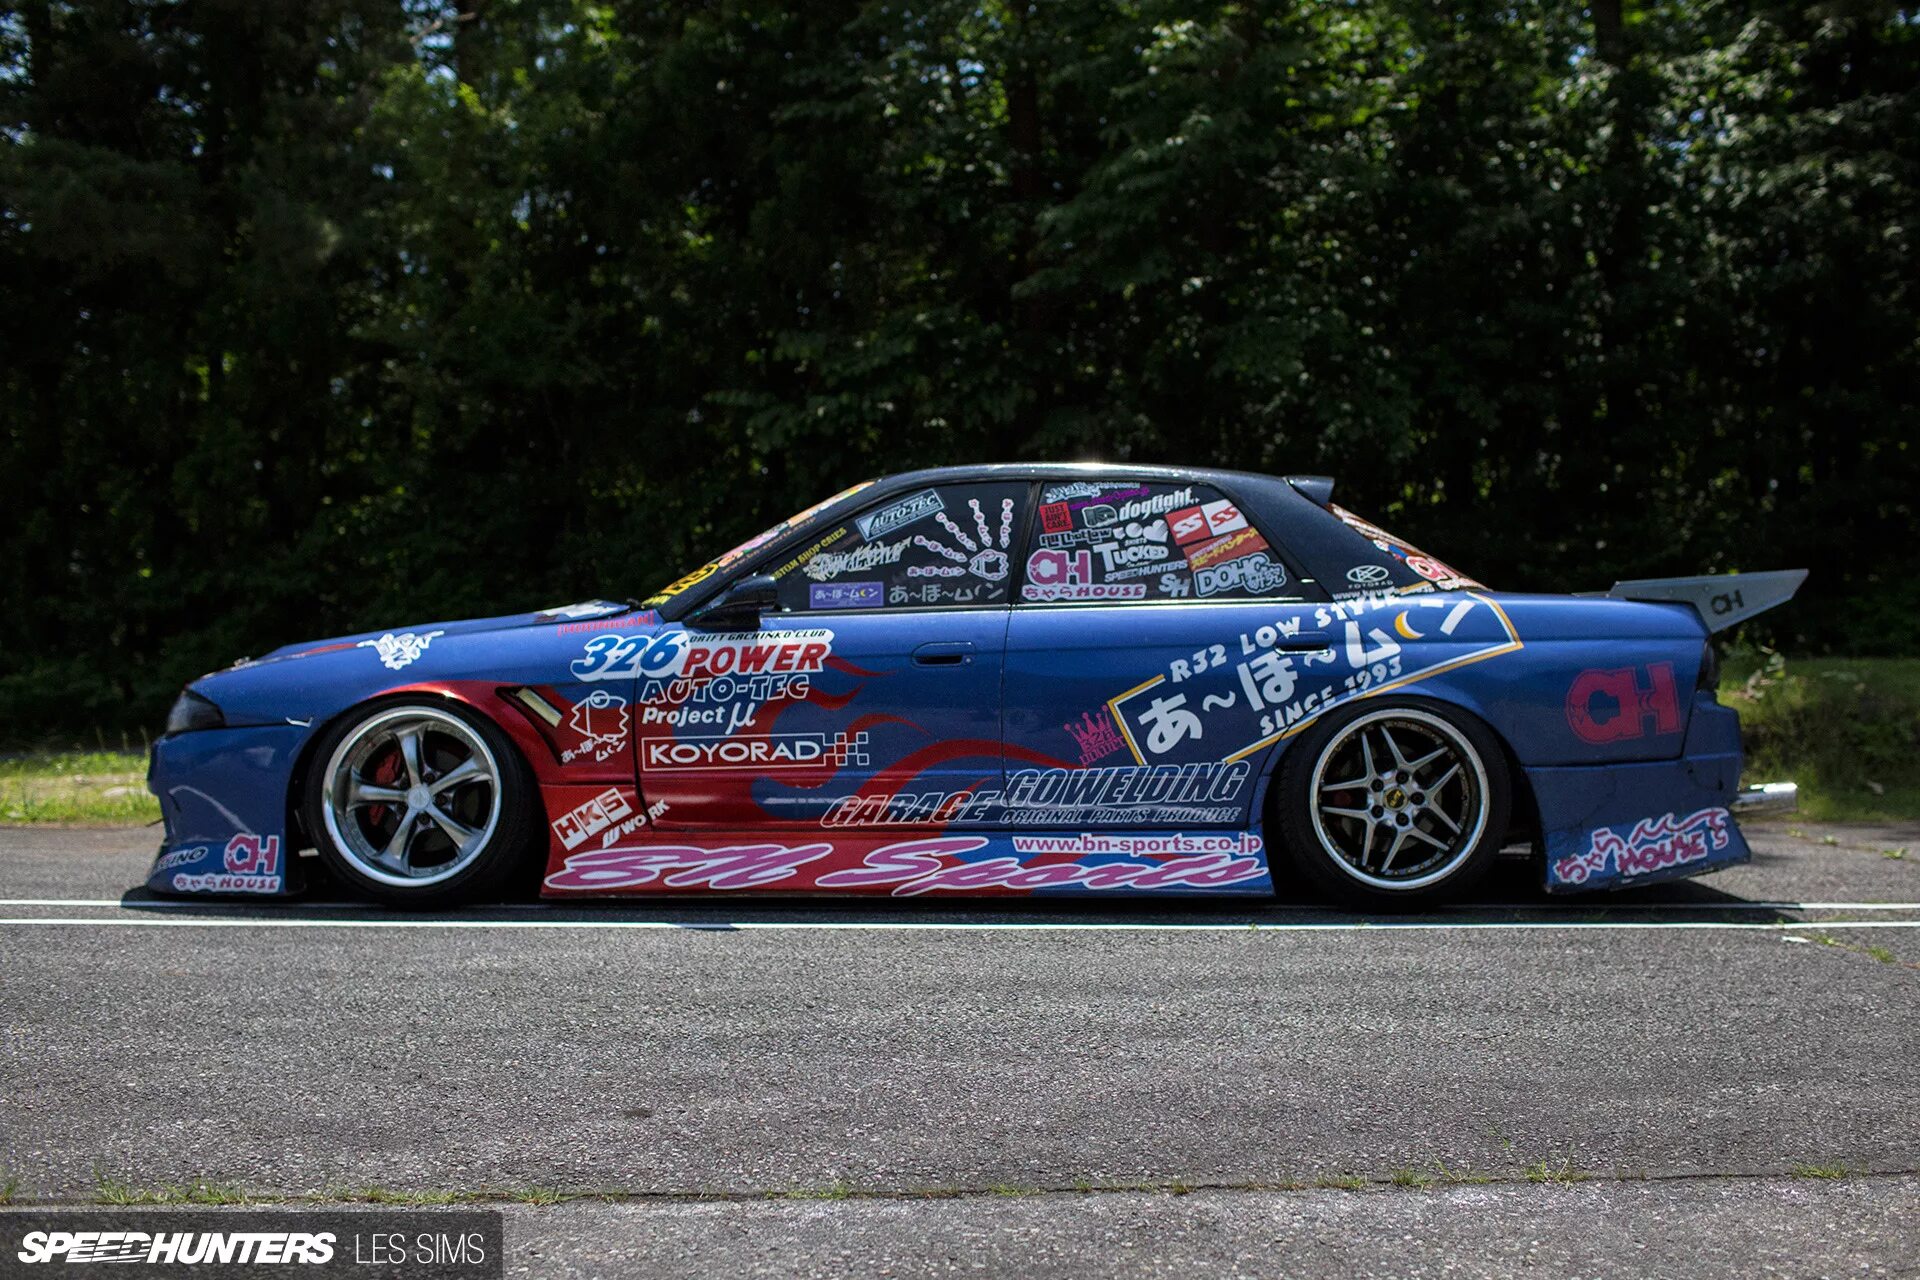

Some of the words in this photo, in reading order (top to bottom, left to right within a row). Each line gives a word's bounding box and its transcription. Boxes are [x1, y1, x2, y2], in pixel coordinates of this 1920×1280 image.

[772, 559, 799, 580] USTOM
[794, 629, 827, 638] CLUB
[1170, 643, 1228, 683] R32
[1240, 616, 1301, 655] LOW
[1314, 583, 1401, 628] STYLE
[571, 630, 690, 682] 326
[681, 643, 828, 676] POWER
[640, 674, 811, 705] AUTO-TEC
[1259, 684, 1335, 737] SINCE
[1344, 657, 1403, 697] 1993
[642, 706, 725, 725] Project
[650, 740, 821, 765] KOYORAD
[554, 789, 628, 844] HKS
[820, 792, 1003, 828] GARAGE
[1000, 808, 1085, 825] ORIGINAL
[1087, 807, 1151, 824] PARTS
[1151, 806, 1243, 824] PRODUCE
[1014, 832, 1264, 857] www.bn-sports.co.jp
